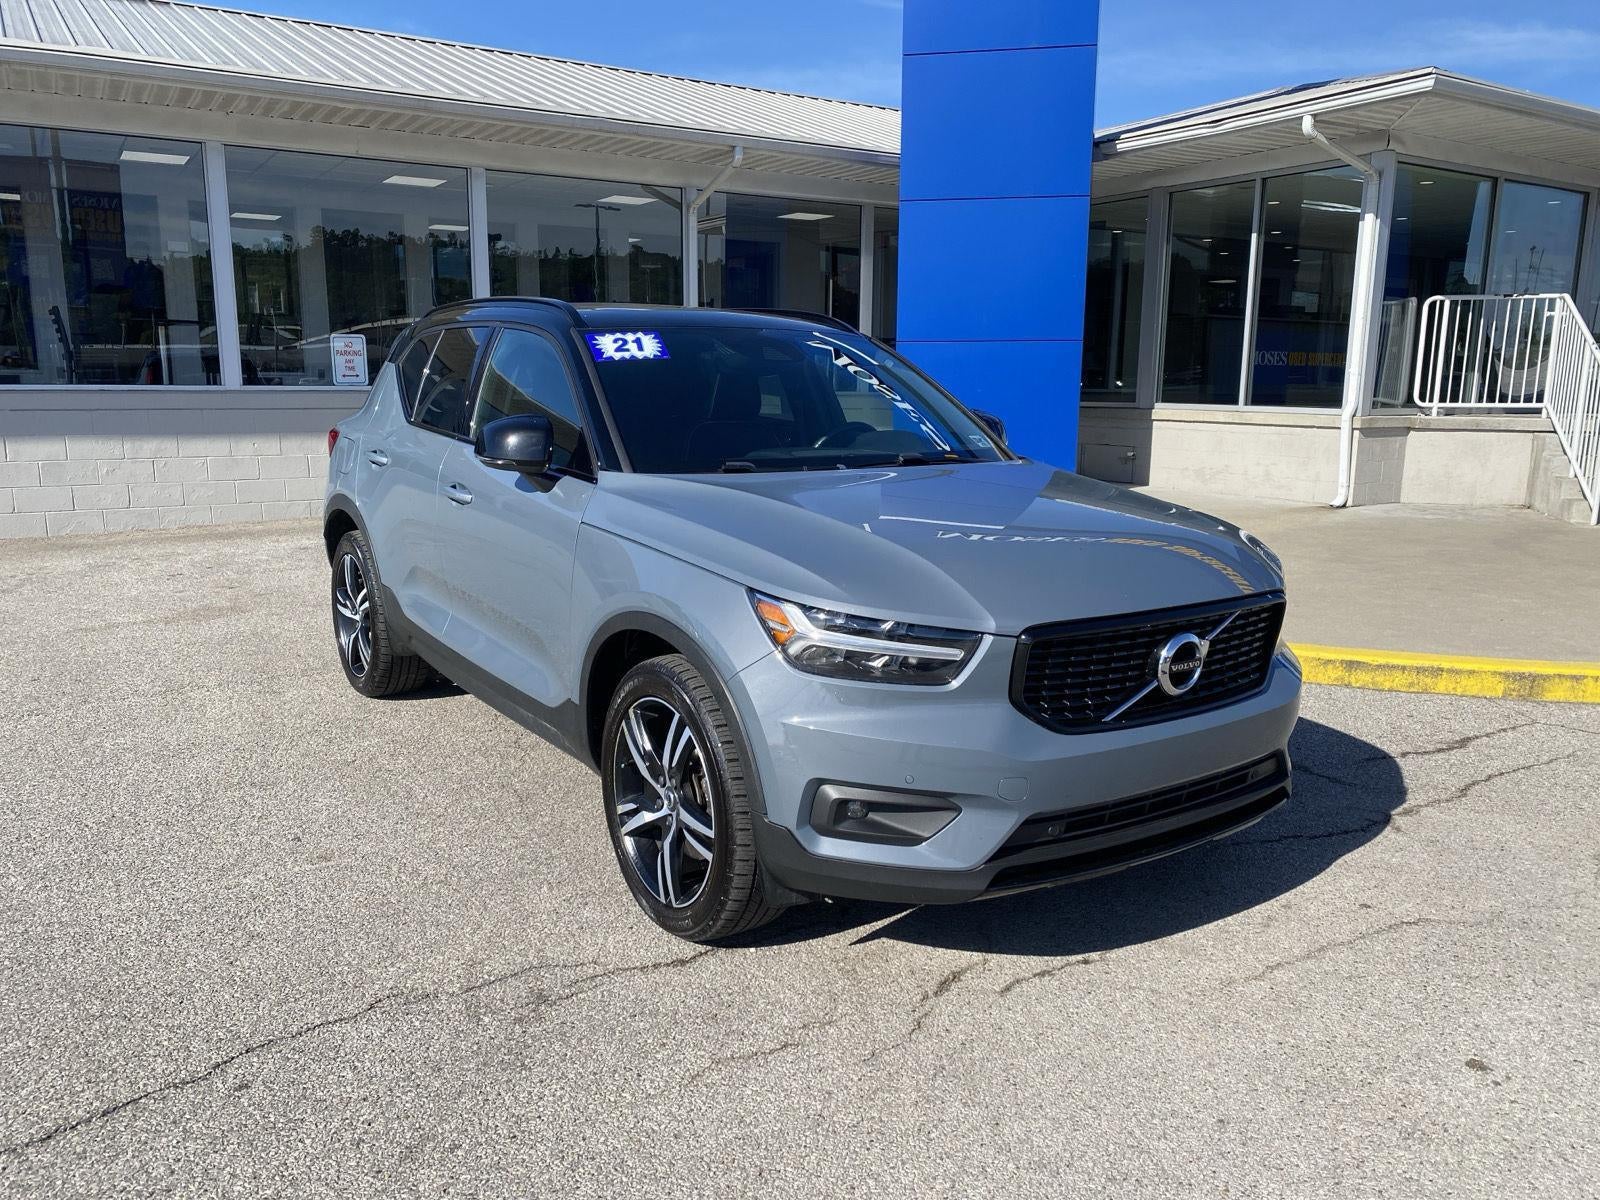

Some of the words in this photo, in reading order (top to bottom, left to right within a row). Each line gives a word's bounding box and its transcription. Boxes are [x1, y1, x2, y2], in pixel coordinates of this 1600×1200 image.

[343, 341, 353, 349] NO
[612, 337, 644, 353] 21
[1255, 350, 1288, 366] OSES
[1170, 661, 1200, 671] VOLVO
